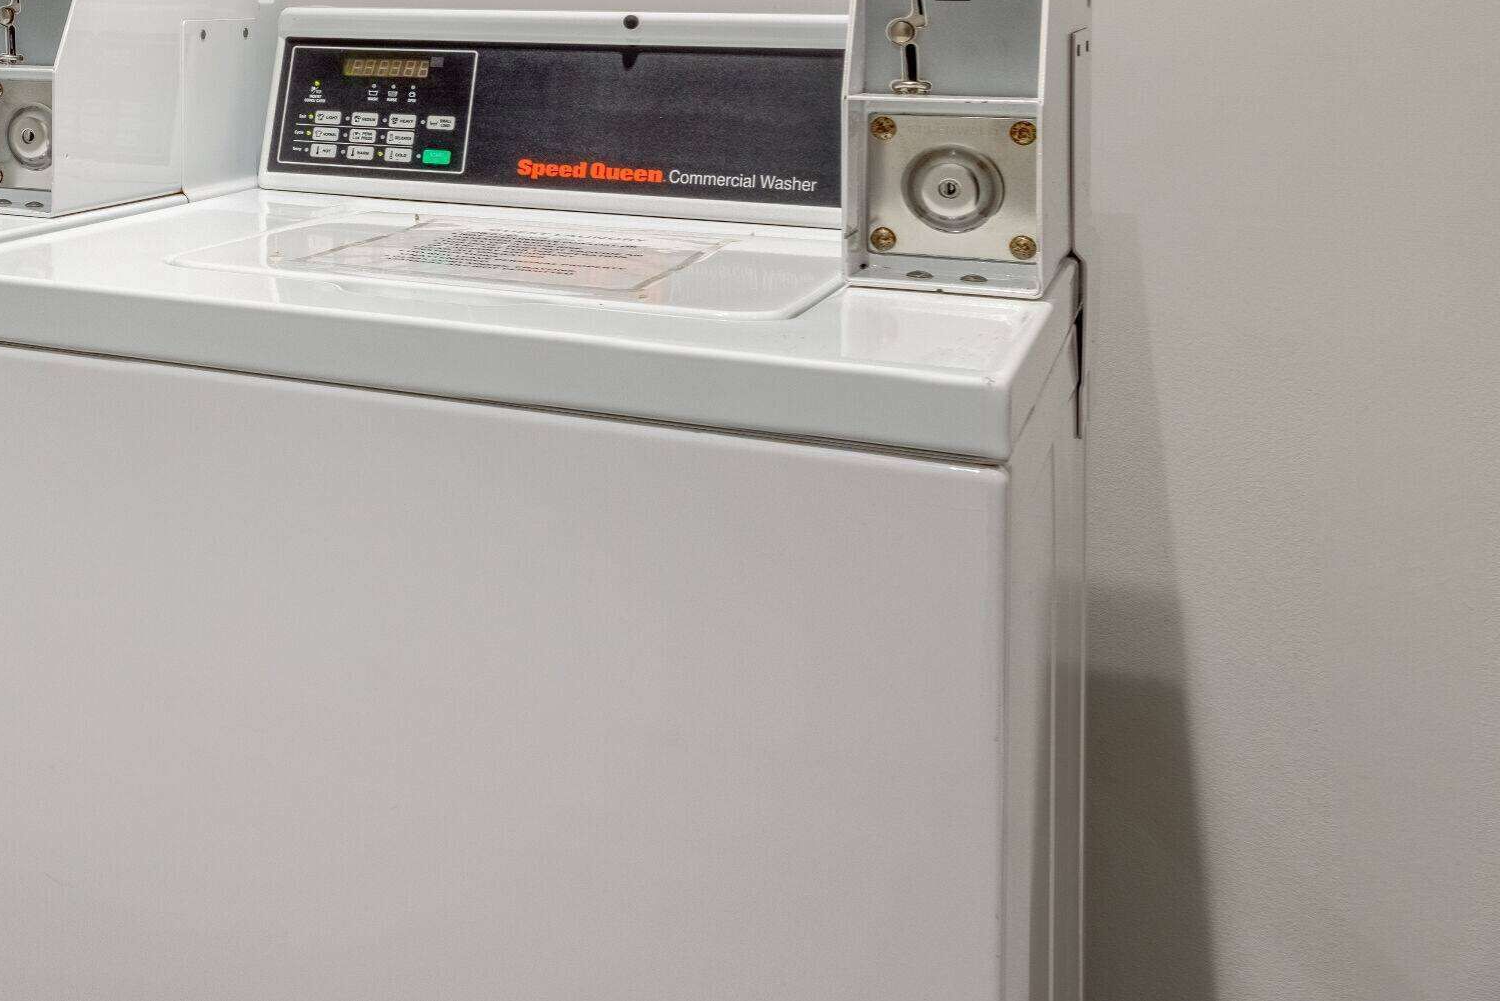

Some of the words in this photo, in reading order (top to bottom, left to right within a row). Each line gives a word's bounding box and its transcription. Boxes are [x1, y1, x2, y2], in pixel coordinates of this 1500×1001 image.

[517, 158, 587, 180] Speed
[590, 161, 663, 184] Queen
[669, 169, 756, 189] Commercial
[760, 174, 818, 192] Washer
